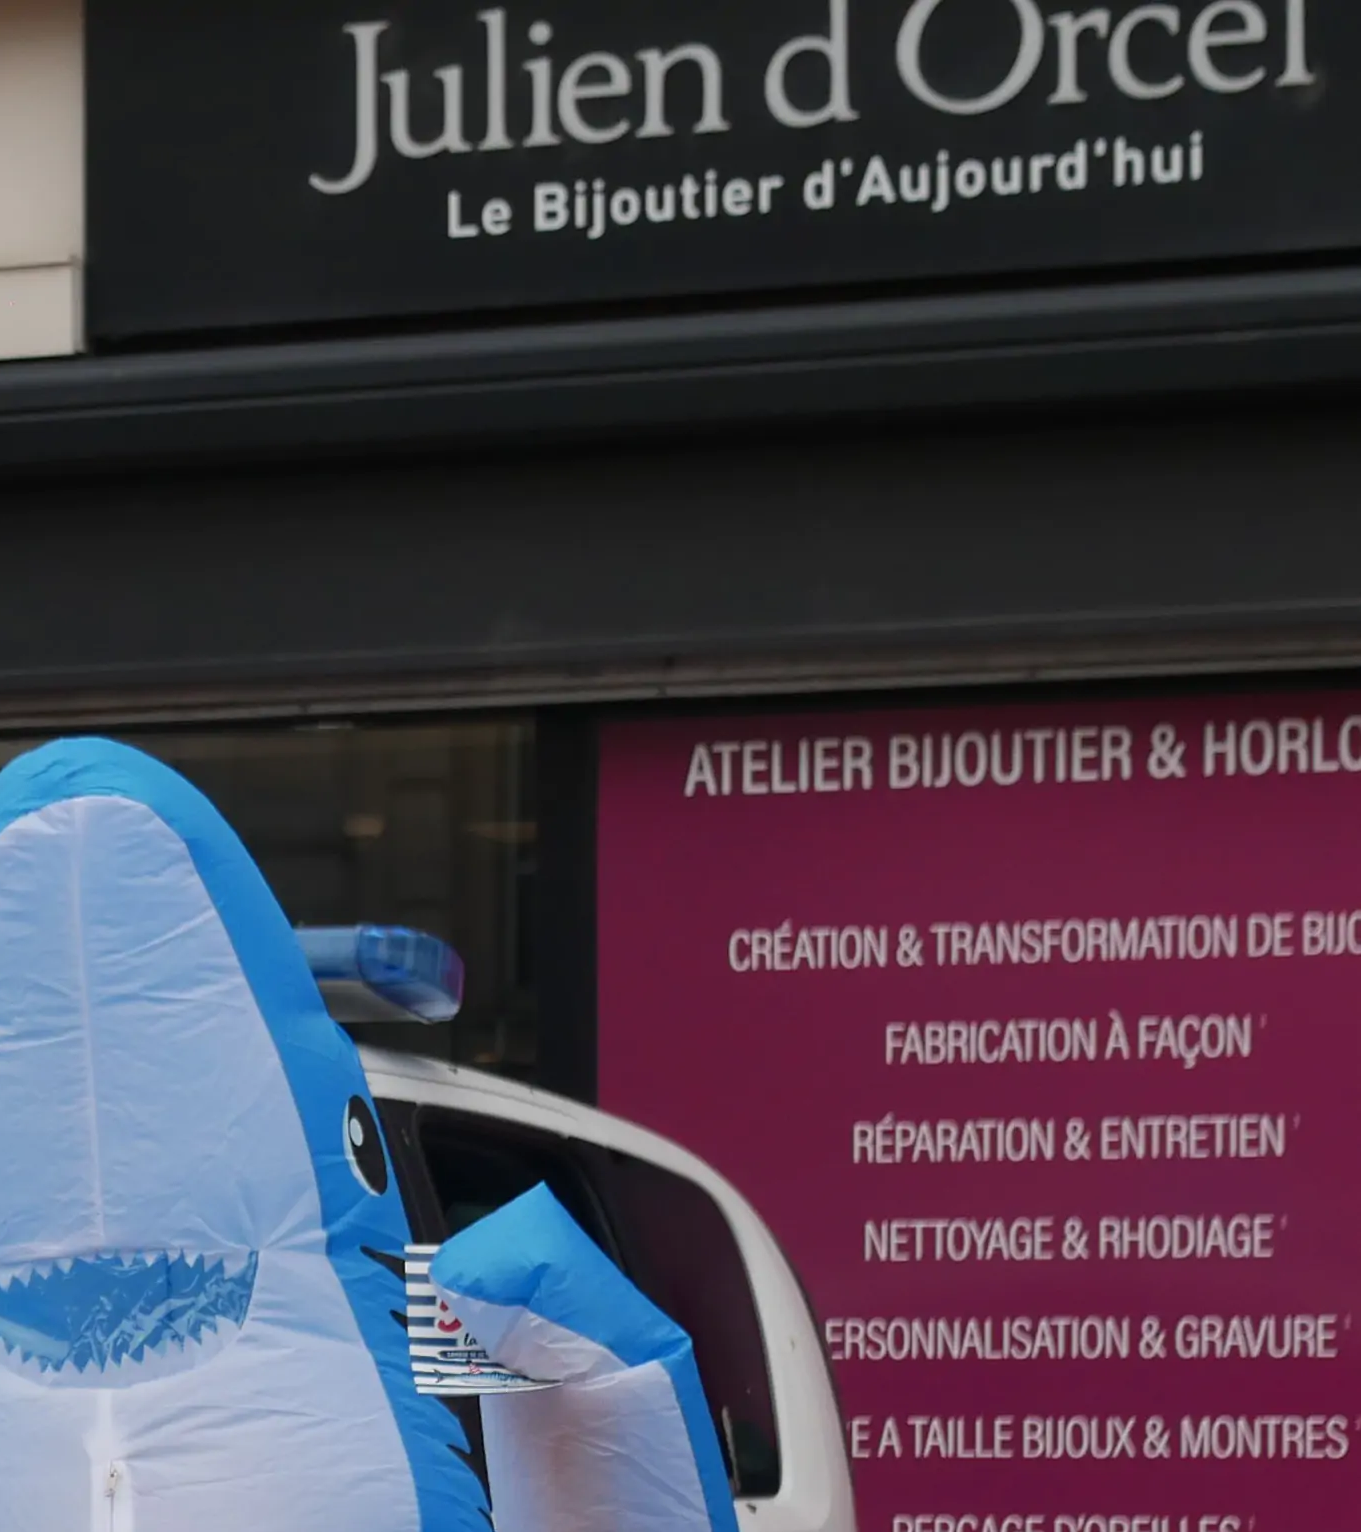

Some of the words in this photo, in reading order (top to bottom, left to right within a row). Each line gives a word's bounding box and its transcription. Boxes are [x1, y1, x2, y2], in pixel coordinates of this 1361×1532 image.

[308, 10, 730, 195] Julien
[447, 190, 512, 238] Le
[532, 171, 784, 239] Bijoutier
[802, 131, 1207, 213] d'Aujourd'hui
[684, 738, 873, 798] ATELIER
[888, 727, 1133, 790] BIJOUTIER
[1146, 724, 1186, 780] &
[729, 919, 888, 972] CRÉATION
[895, 924, 924, 968] &
[929, 914, 1238, 966] TRANSFORMATION
[1246, 912, 1294, 958] DE
[885, 1016, 1097, 1065] FABRICATION
[1104, 1009, 1131, 1061] À
[1137, 1012, 1253, 1070] FAÇON
[852, 1113, 1055, 1164] RÉPARATION
[1063, 1117, 1091, 1161] &
[1100, 1113, 1286, 1160] ENTRETIEN
[864, 1217, 1054, 1262] NETTOYAGE
[1061, 1217, 1089, 1260] &
[1098, 1213, 1275, 1260] RHODIAGE
[1138, 1315, 1167, 1359] &
[1174, 1313, 1337, 1359] GRAVURE
[877, 1415, 903, 1459] A
[907, 1415, 1013, 1459] TAILLE
[1022, 1414, 1136, 1459] BIJOUX
[1142, 1415, 1171, 1459] &
[1180, 1414, 1349, 1459] MONTRES
